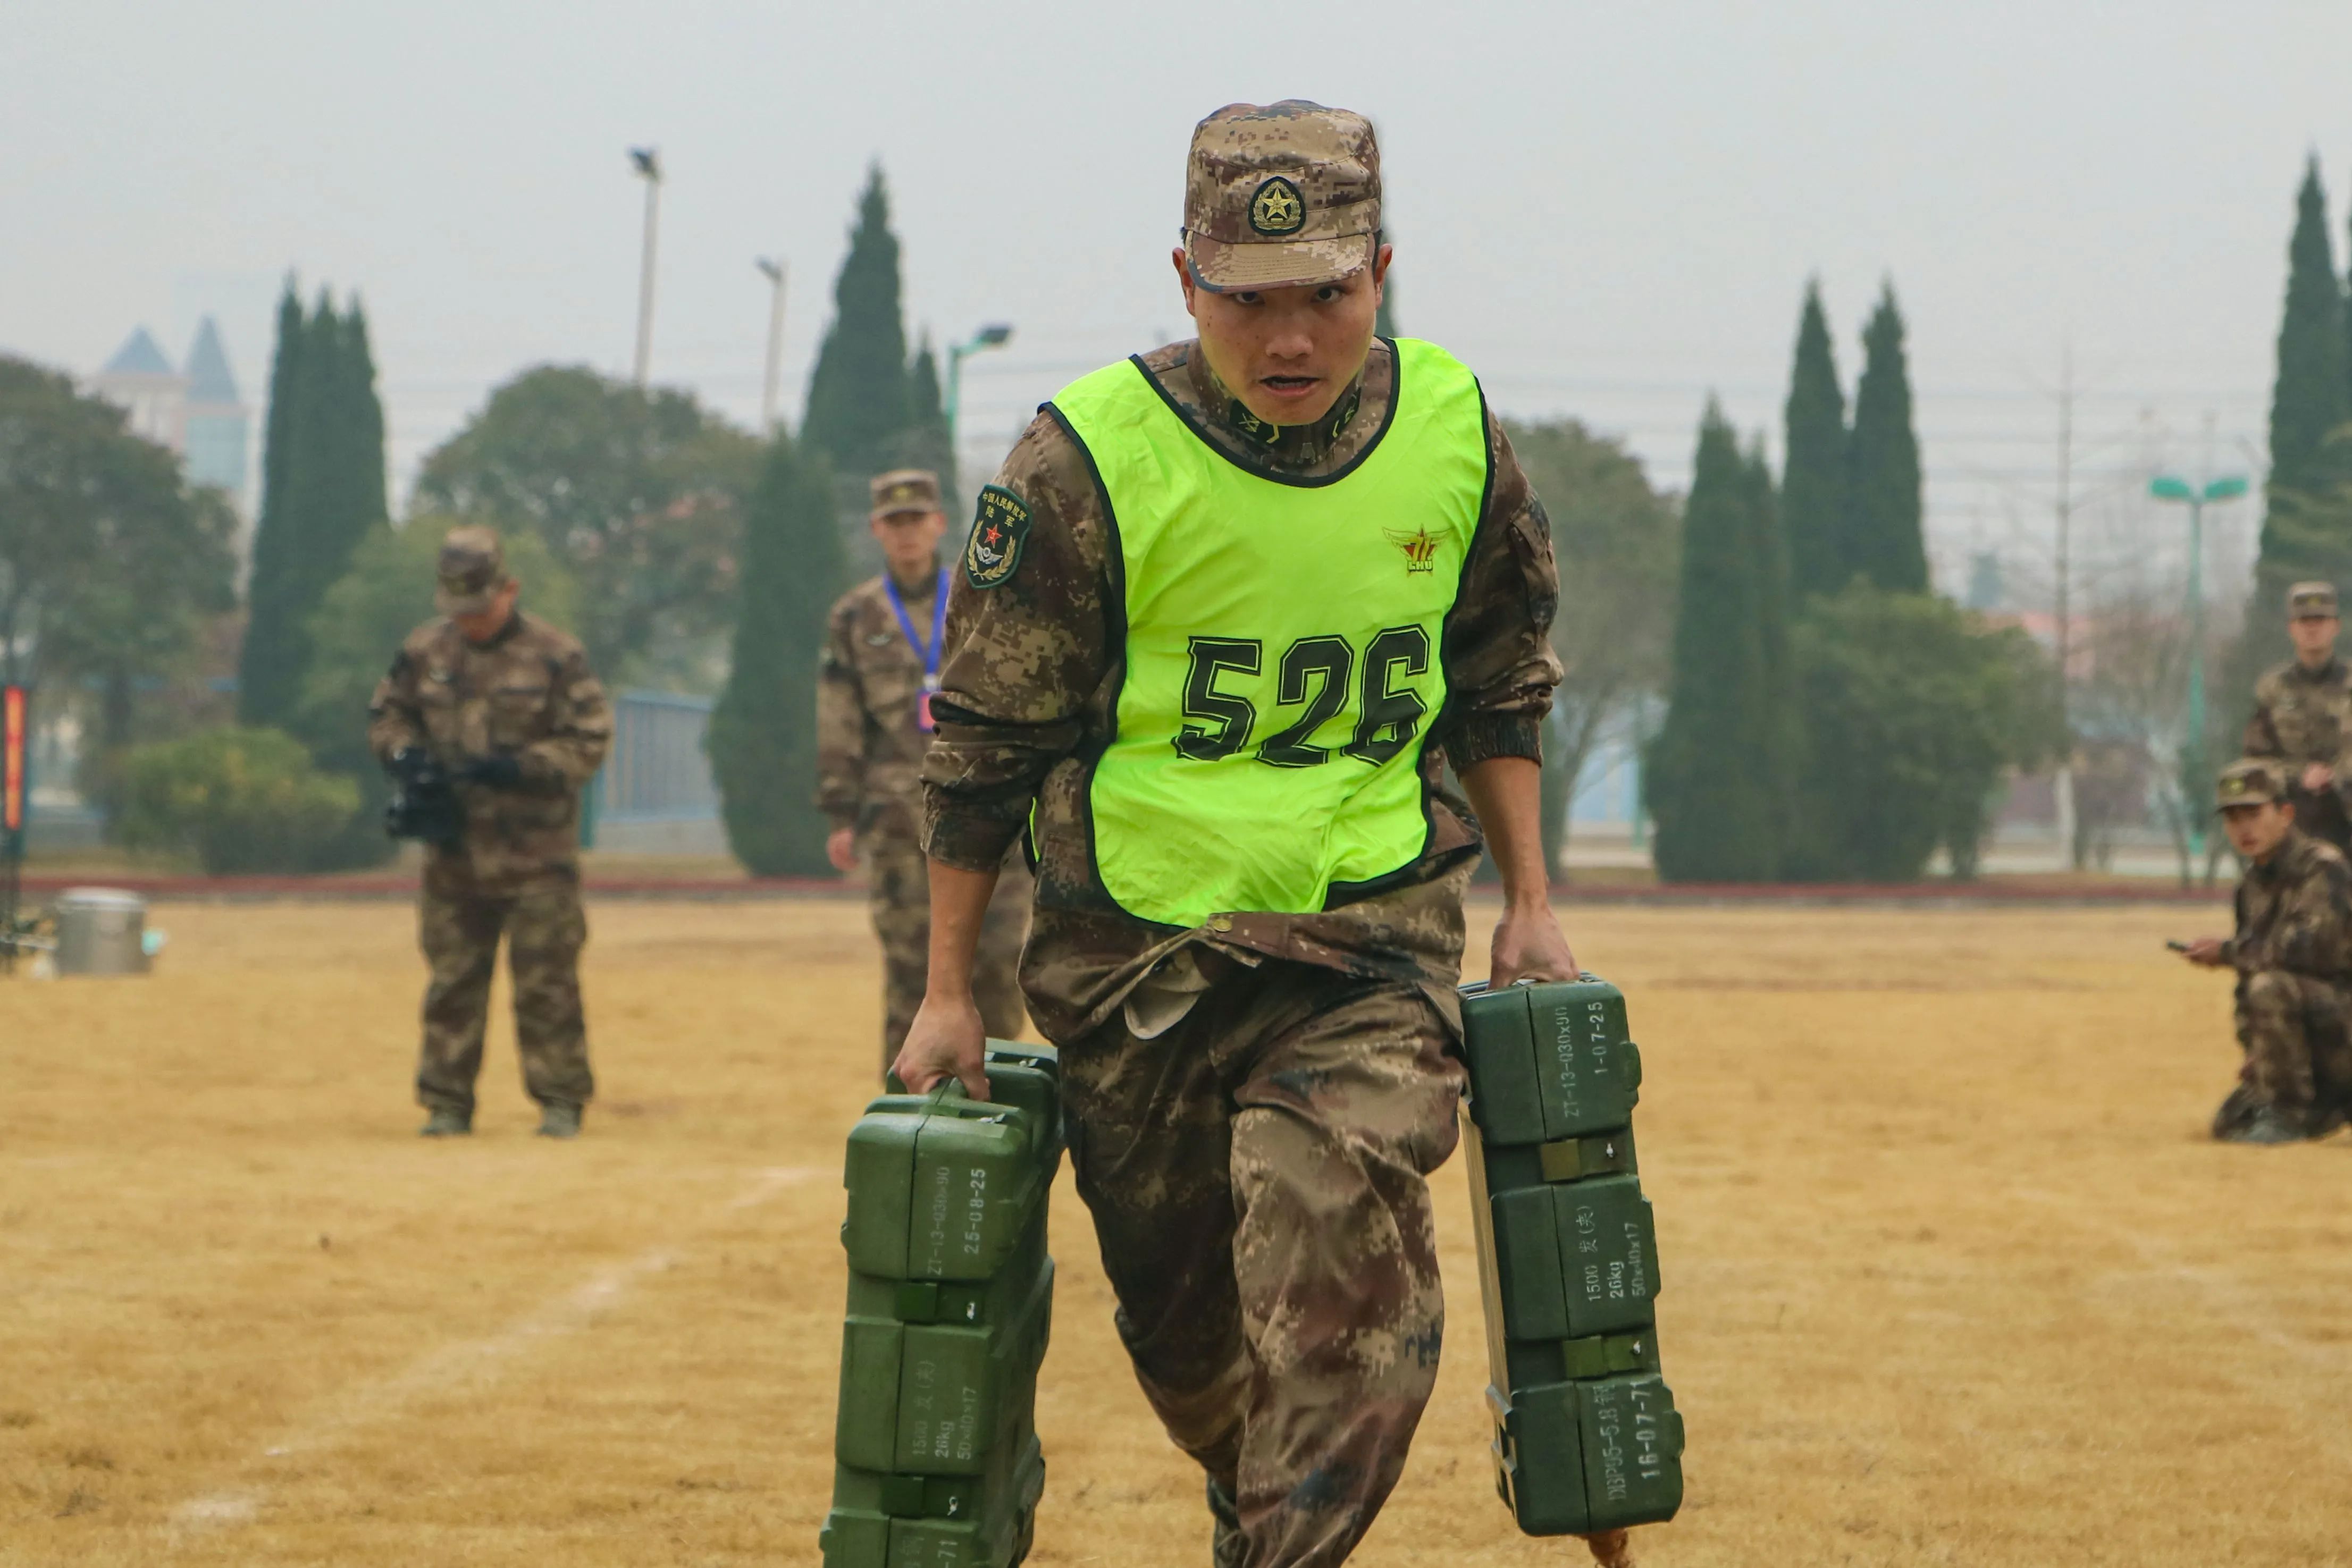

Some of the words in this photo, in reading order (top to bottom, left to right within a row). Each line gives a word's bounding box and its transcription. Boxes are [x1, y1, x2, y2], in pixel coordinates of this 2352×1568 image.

[982, 492, 1027, 522] 中国人民解放军
[1171, 624, 1430, 769] 526
[1587, 1001, 1608, 1074] 1-07-25
[1585, 1264, 1602, 1302] 1500
[1607, 1261, 1625, 1299] 26kg
[935, 1421, 955, 1459] 26kg
[1629, 1379, 1661, 1480] 16-07-71
